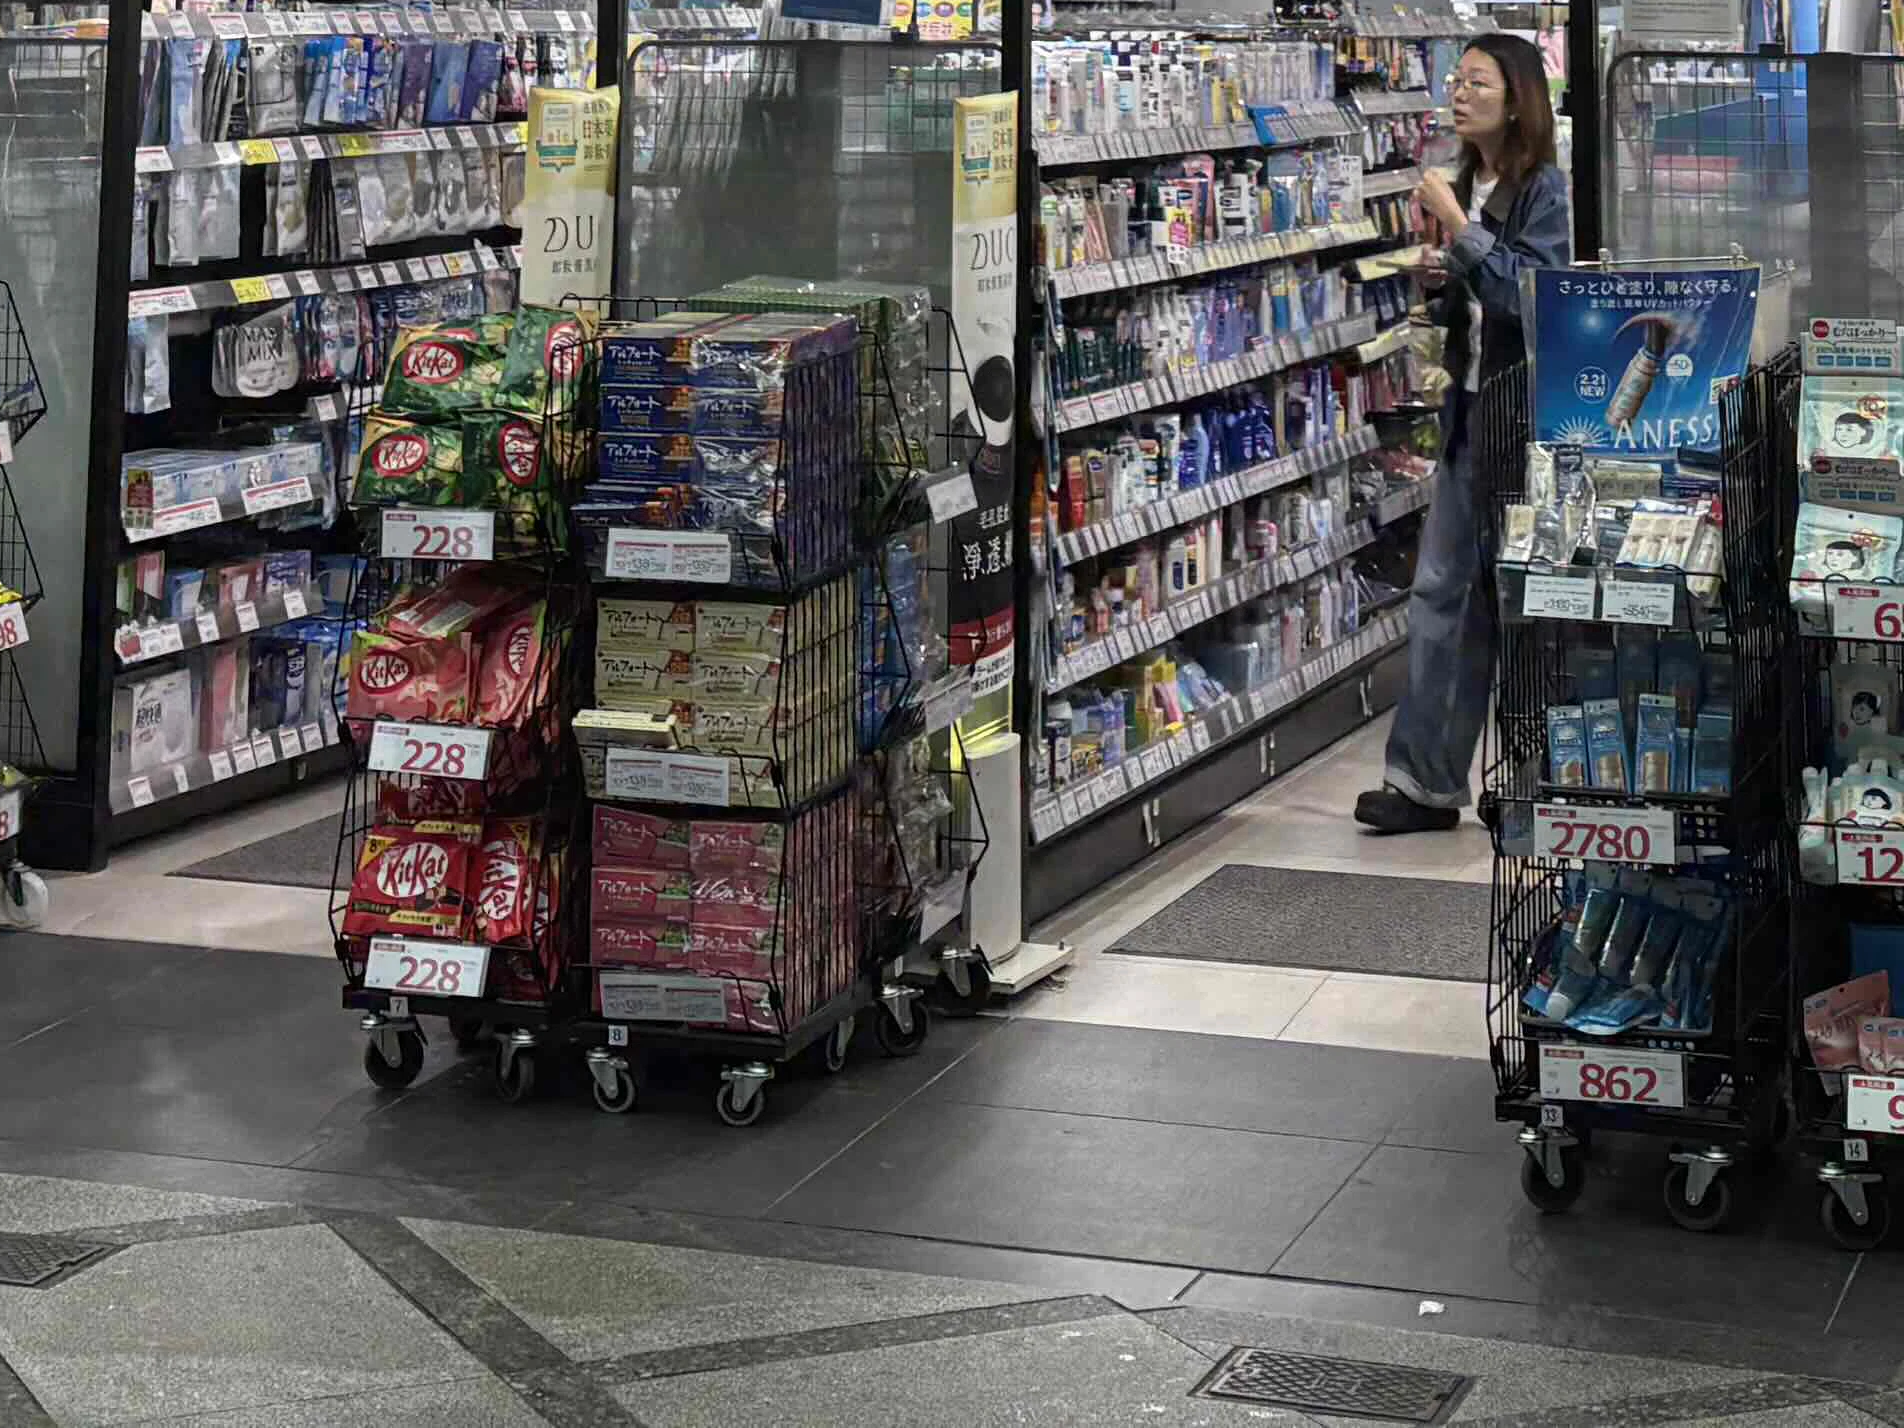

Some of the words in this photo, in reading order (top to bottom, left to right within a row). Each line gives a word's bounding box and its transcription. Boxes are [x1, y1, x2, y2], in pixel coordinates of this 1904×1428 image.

[543, 214, 594, 253] DU
[410, 344, 455, 378] KitKat
[1579, 373, 1606, 386] 2.21
[1579, 385, 1607, 398] NEW
[1614, 414, 1720, 449] ANESS
[412, 525, 474, 558] 228
[364, 656, 410, 689] KitKat
[399, 738, 467, 776] 228
[1549, 822, 1651, 860] 2780
[382, 843, 448, 897] KitKat
[397, 955, 462, 993] 228
[1579, 1063, 1659, 1102] 862
